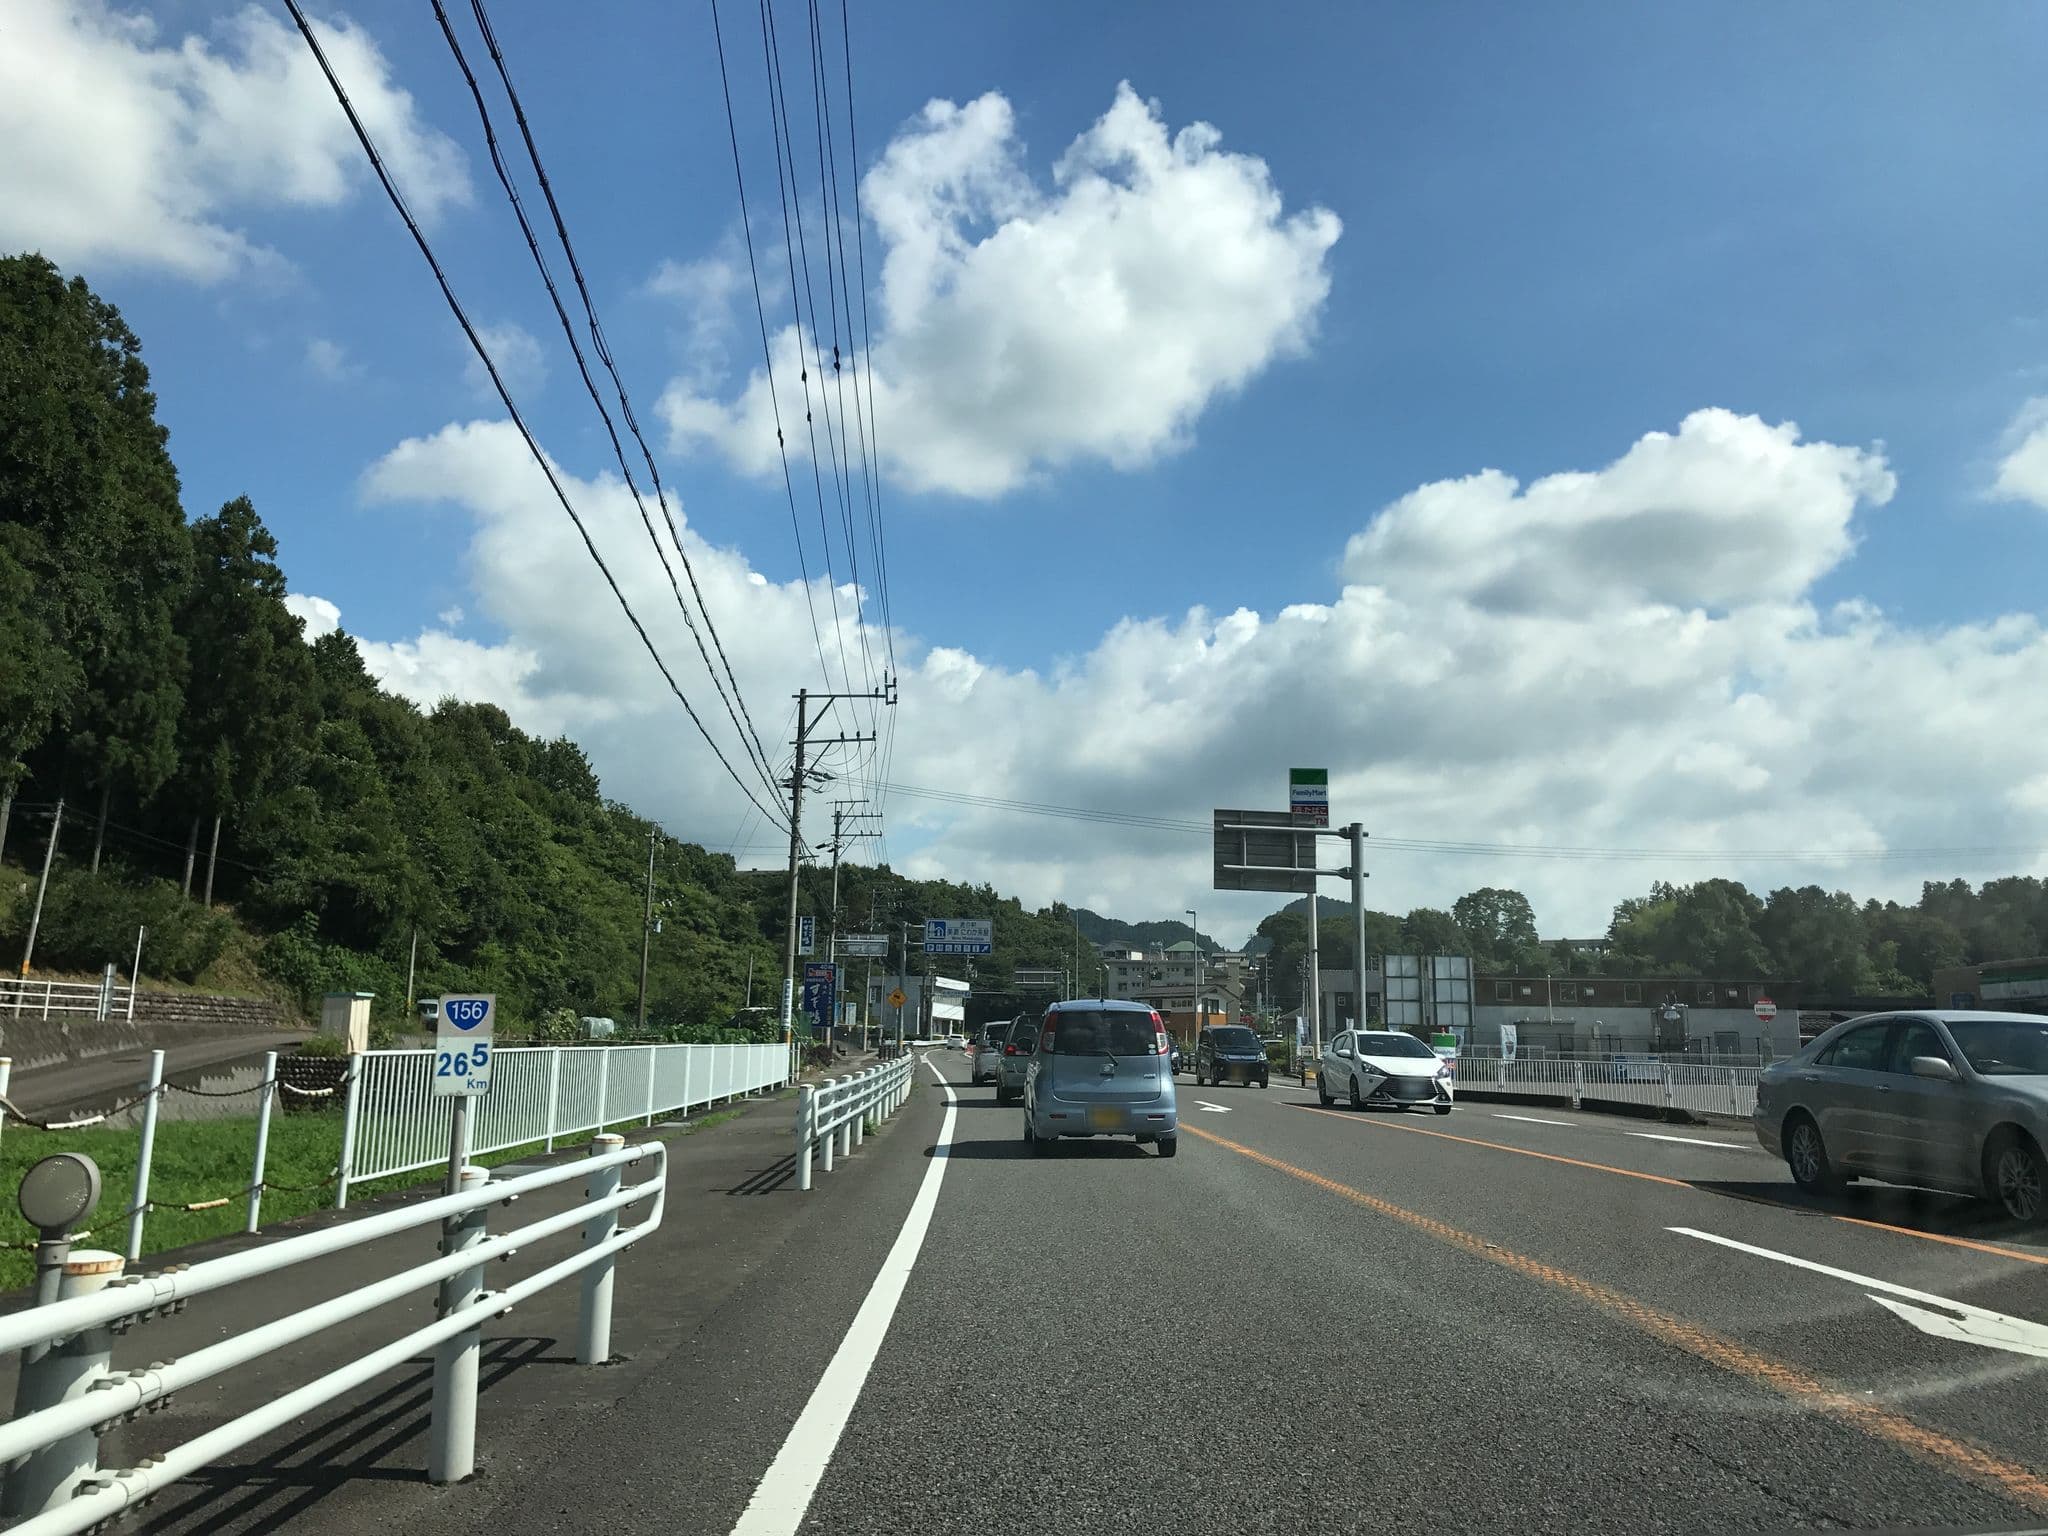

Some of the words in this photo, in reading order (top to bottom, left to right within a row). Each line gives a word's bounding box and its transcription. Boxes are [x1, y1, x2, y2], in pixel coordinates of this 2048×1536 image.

[1292, 789, 1327, 797] FamilyMart
[452, 1002, 482, 1020] 156
[437, 1043, 488, 1076] 26.5
[466, 1078, 488, 1089] Km
